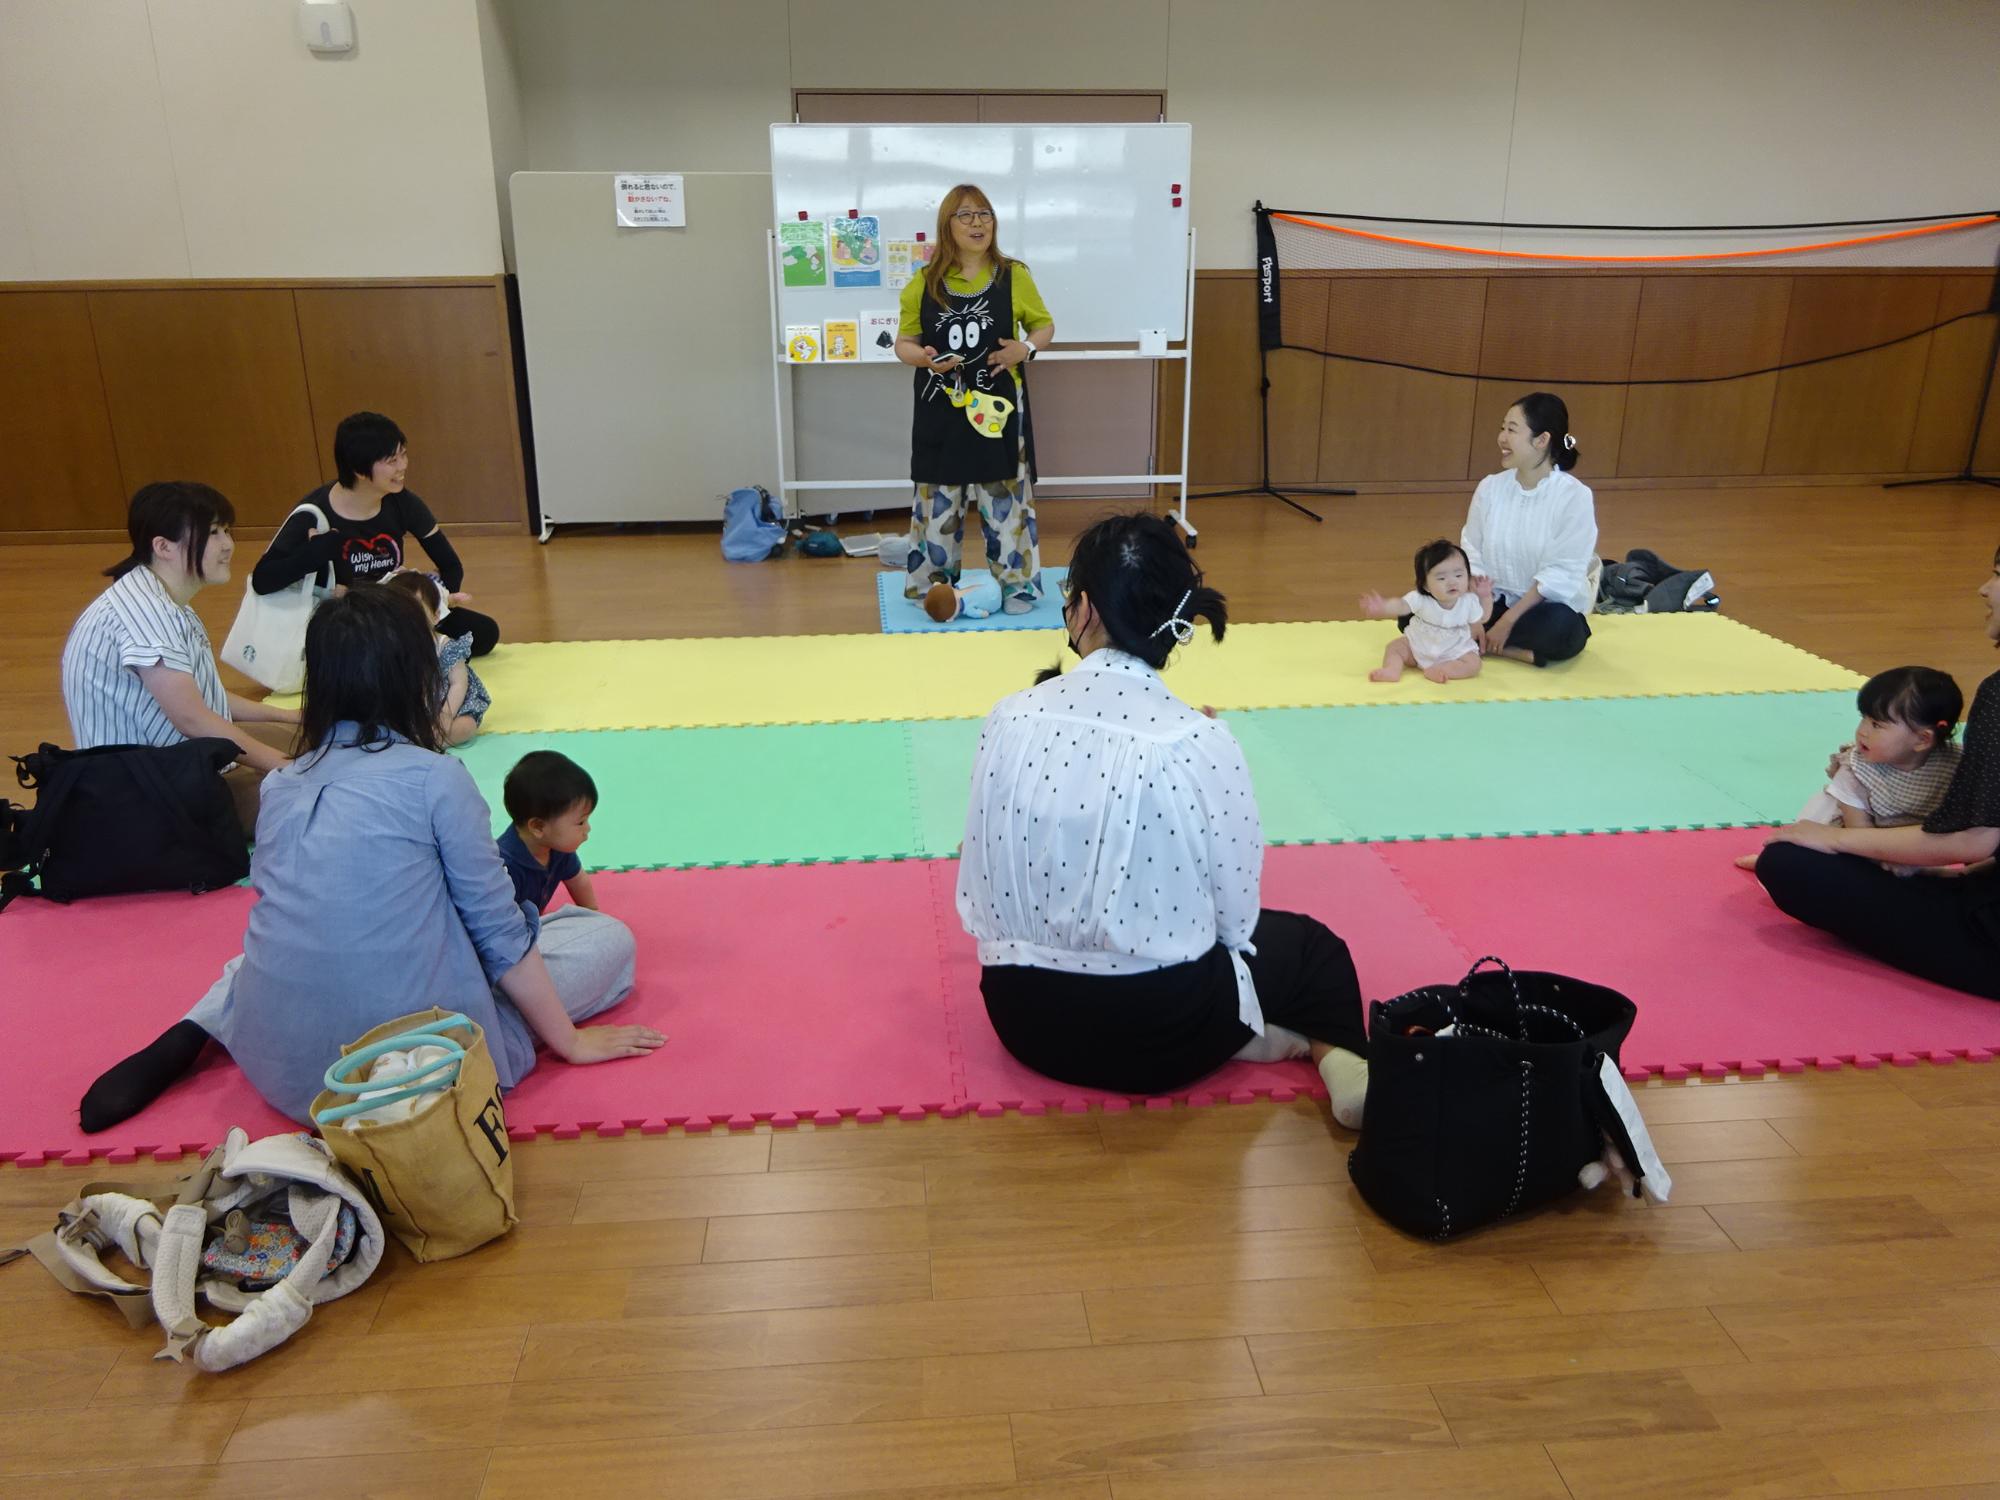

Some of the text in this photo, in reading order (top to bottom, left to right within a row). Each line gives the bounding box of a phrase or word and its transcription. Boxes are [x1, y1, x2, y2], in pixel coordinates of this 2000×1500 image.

[871, 317, 899, 326] おにぎり
[351, 552, 374, 564] Wish
[355, 557, 394, 573] my Heart
